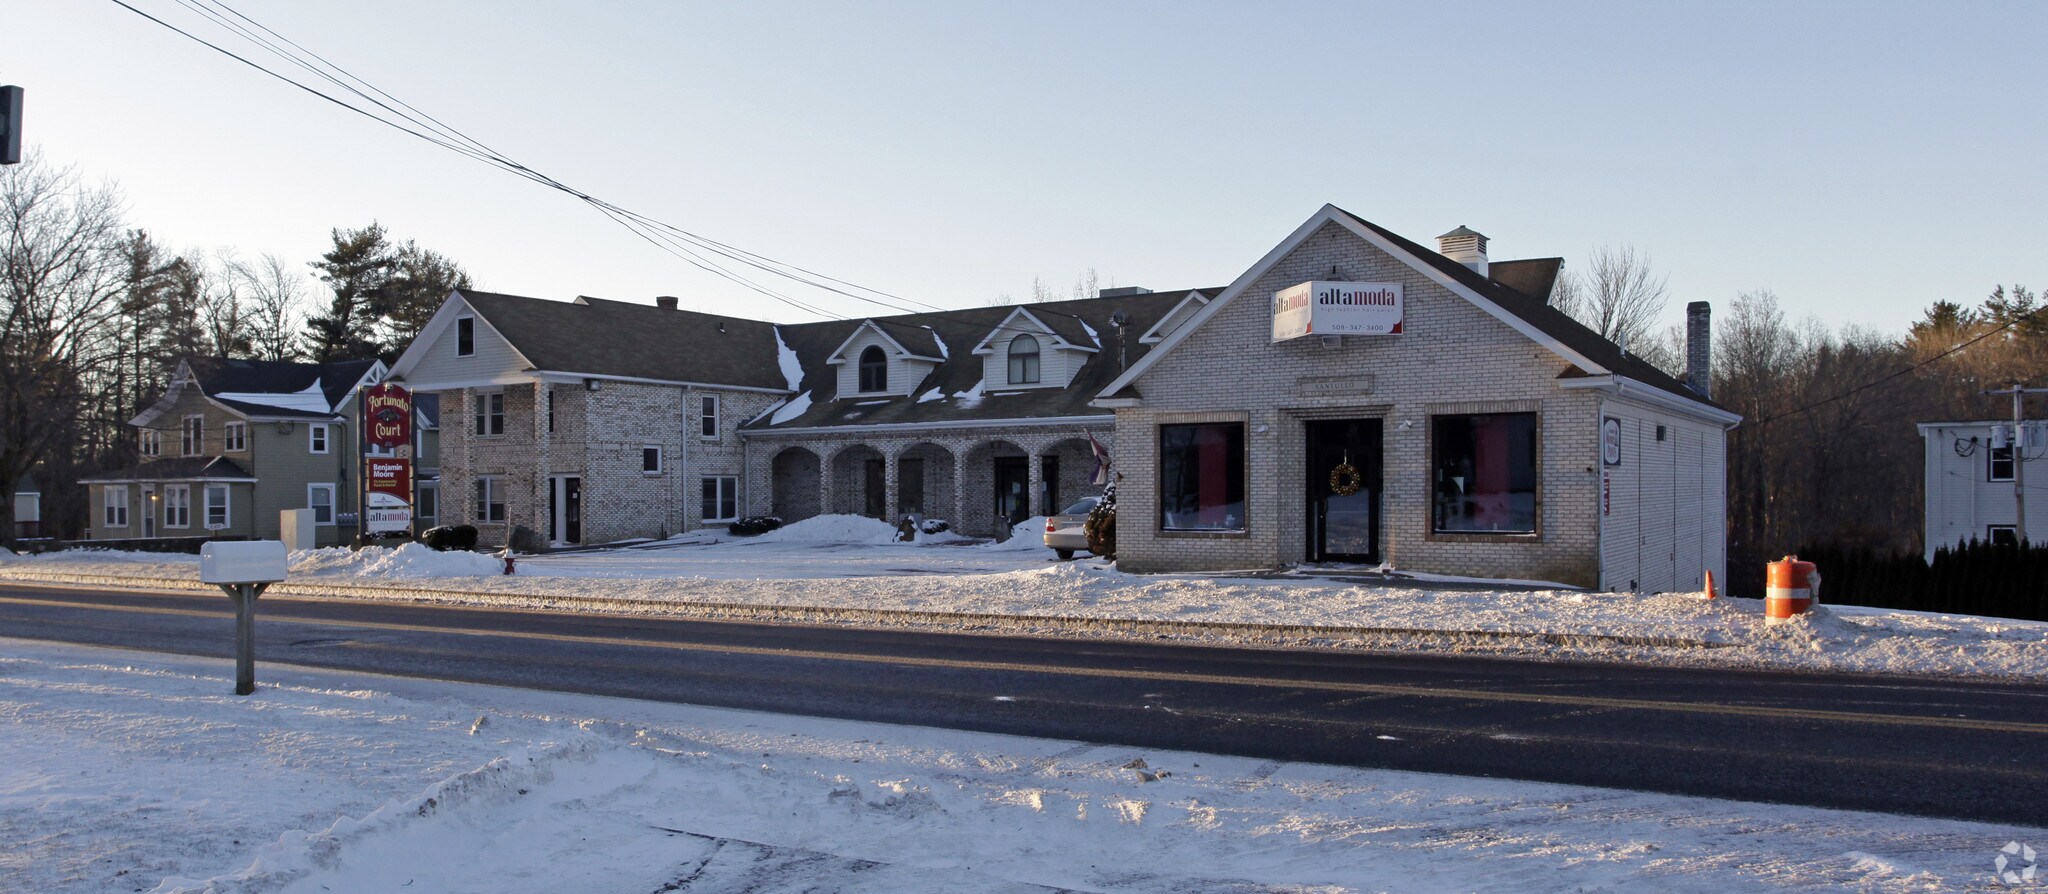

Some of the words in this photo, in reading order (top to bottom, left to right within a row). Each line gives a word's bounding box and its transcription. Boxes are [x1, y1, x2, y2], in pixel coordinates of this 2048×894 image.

[1273, 290, 1309, 314] altamoda
[1320, 288, 1395, 306] altamoda
[368, 394, 409, 413] Fortunato
[375, 422, 401, 440] Court
[373, 463, 403, 472] Benjamin
[373, 470, 394, 478] Moore
[370, 511, 409, 522] altamoda
